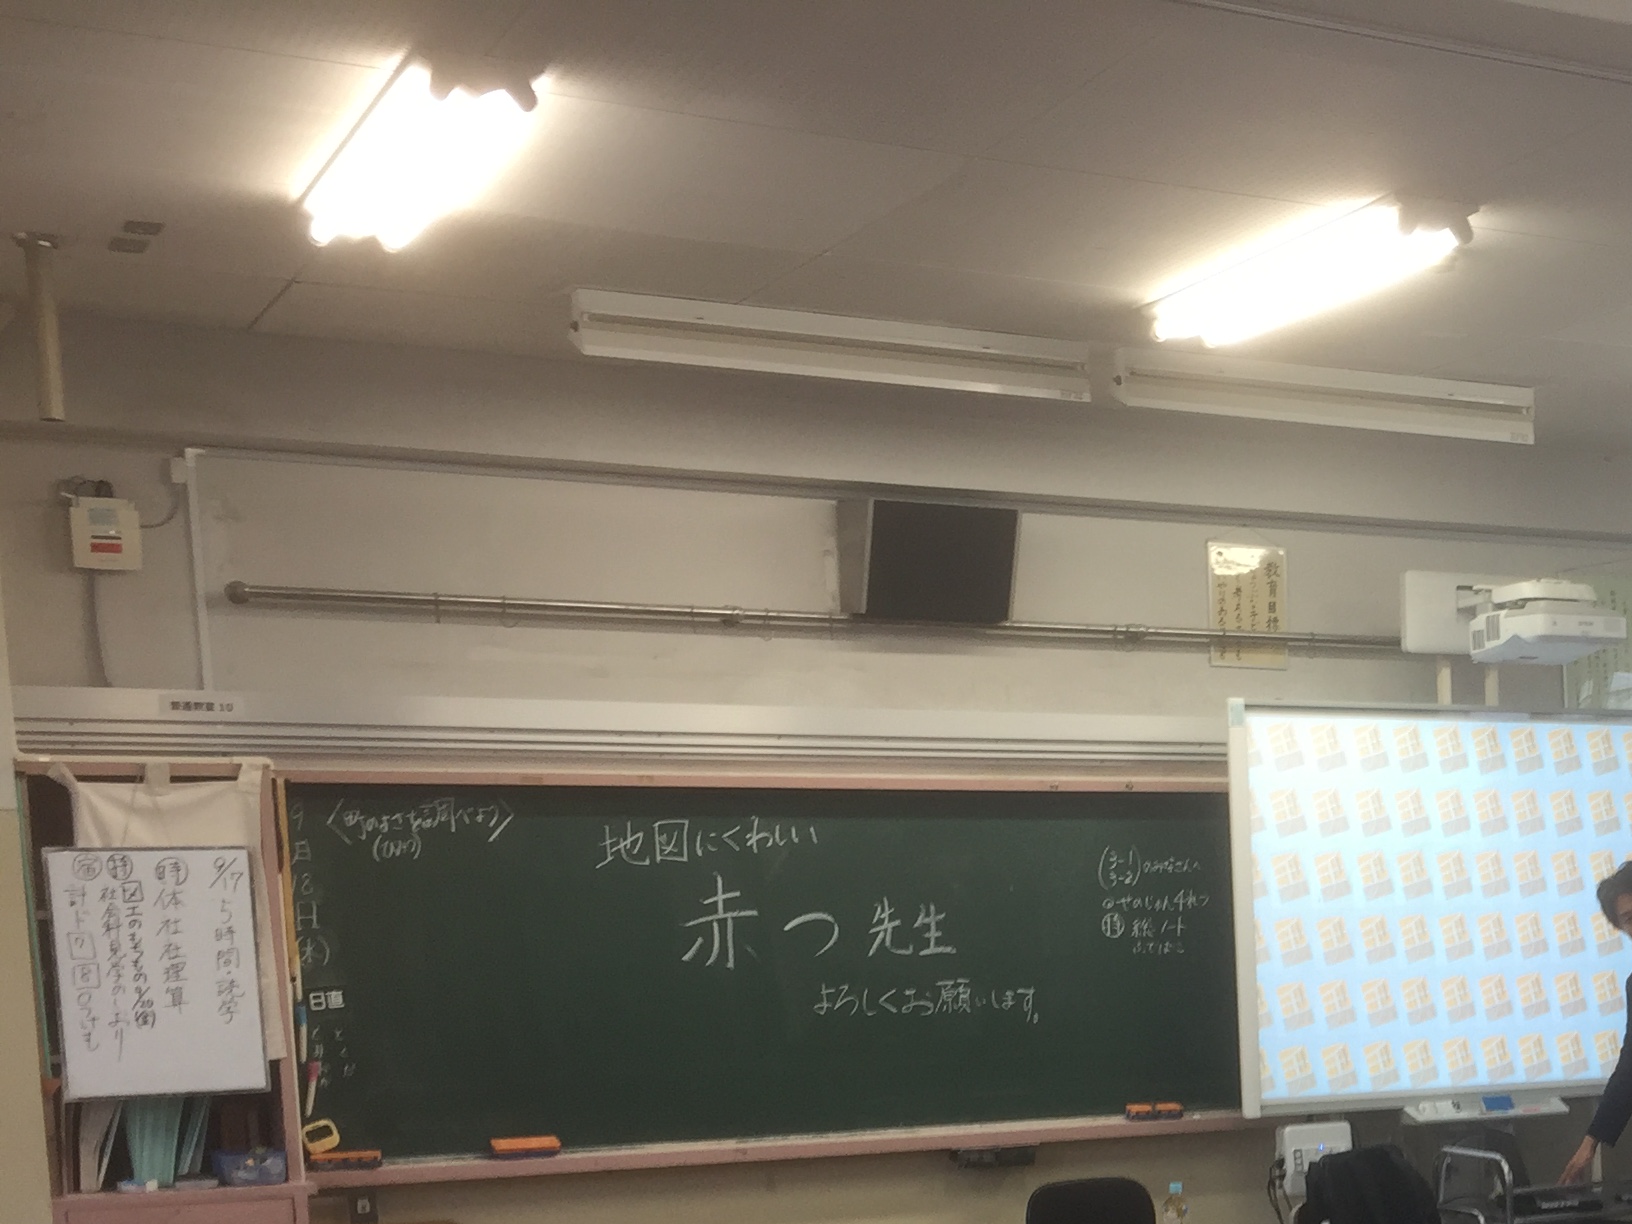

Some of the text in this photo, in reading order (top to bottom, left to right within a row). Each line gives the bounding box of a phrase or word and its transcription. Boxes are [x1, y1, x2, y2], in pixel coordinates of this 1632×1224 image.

[595, 816, 819, 869] 地図にくわしい
[309, 988, 346, 1011] 日直
